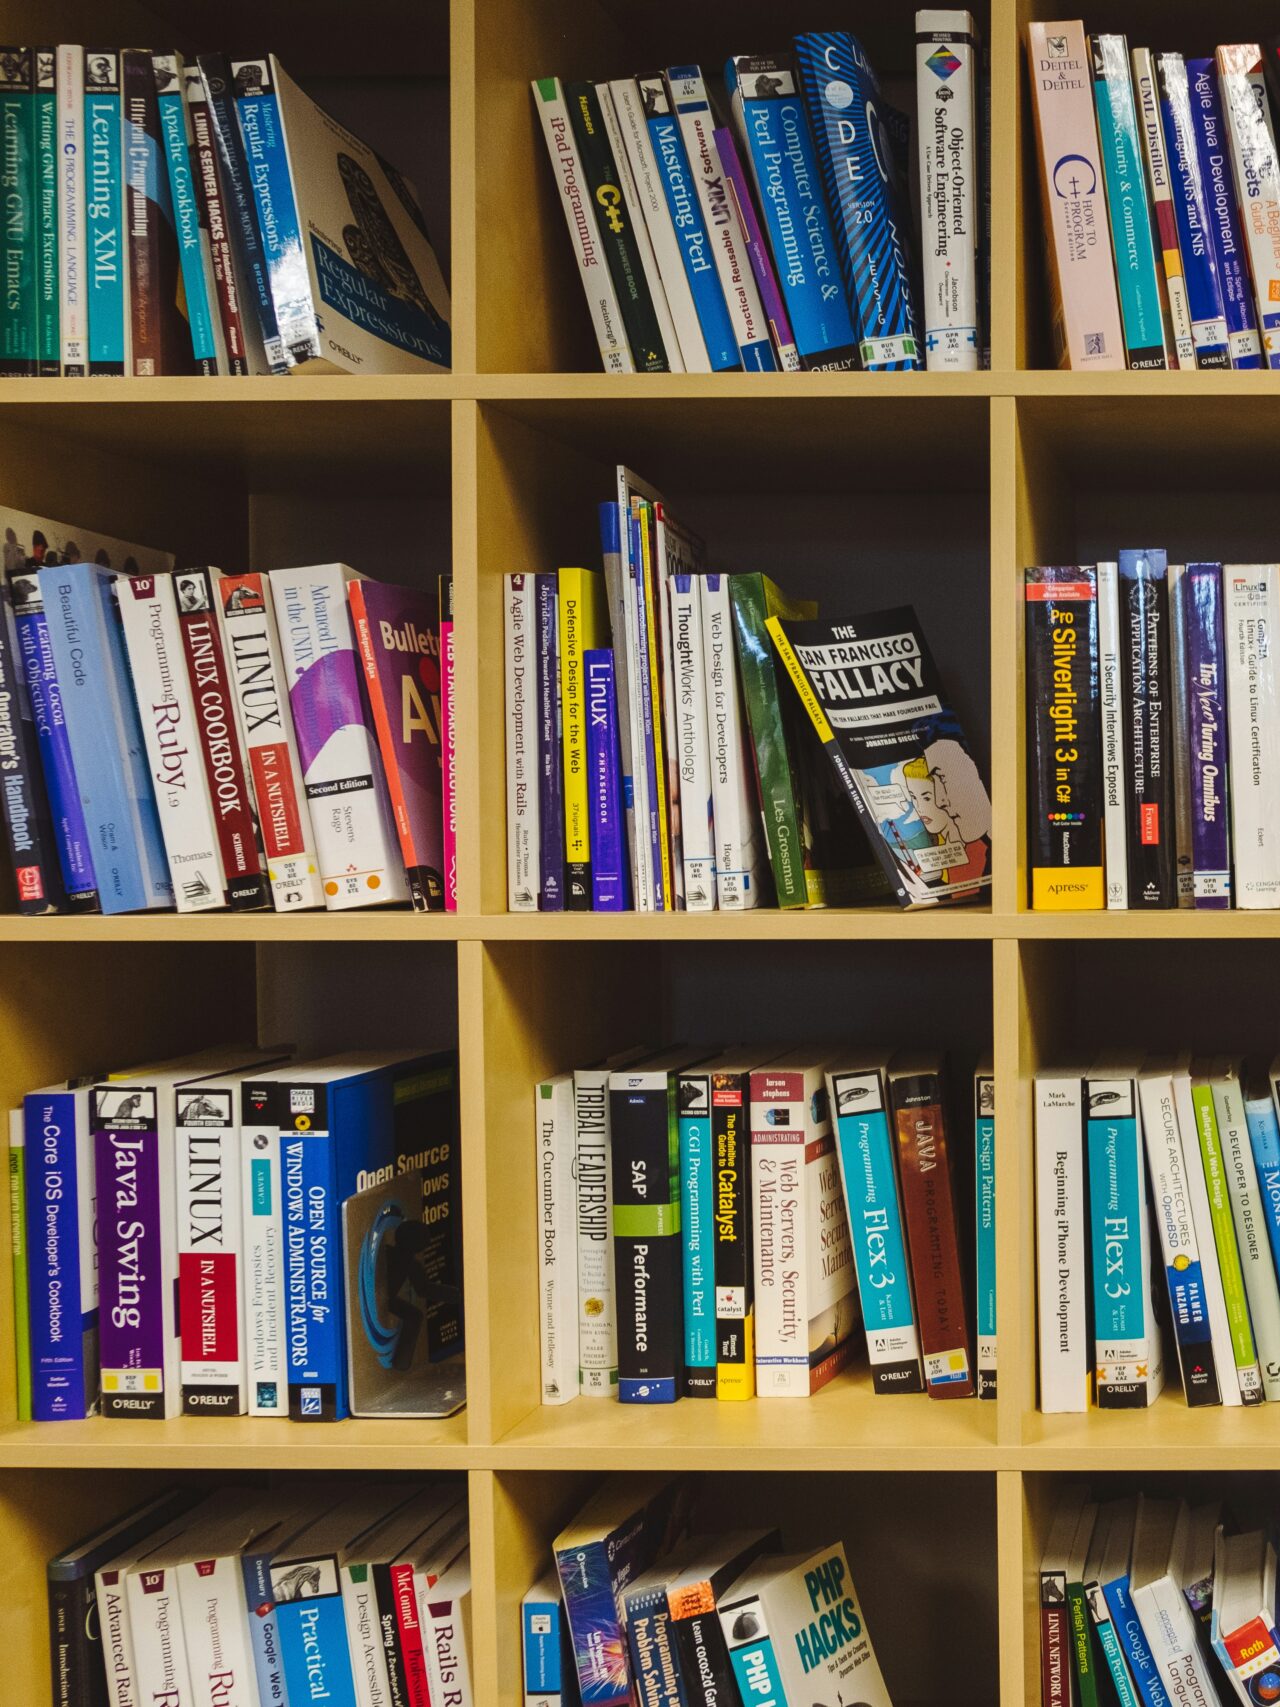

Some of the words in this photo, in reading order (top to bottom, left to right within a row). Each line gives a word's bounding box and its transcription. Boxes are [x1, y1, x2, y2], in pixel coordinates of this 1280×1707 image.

[1196, 73, 1213, 109] Agile
[193, 112, 210, 147] LINUX
[934, 107, 948, 169] Software
[1140, 77, 1154, 119] UML
[1149, 122, 1165, 186] Distilled
[1204, 114, 1217, 148] Java
[89, 103, 114, 219] Learning
[163, 103, 183, 162] Apache
[175, 166, 196, 249] Cookbook
[201, 150, 217, 196] SERVER
[242, 104, 263, 161] Regular
[253, 164, 280, 252] Expressions
[950, 127, 965, 235] Object-Oriented
[206, 199, 224, 240] HACKS
[550, 117, 570, 153] iPad
[562, 156, 598, 268] Programming
[655, 125, 694, 228] Mastering
[684, 231, 711, 272] Perl
[935, 172, 951, 257] Engineering
[1210, 155, 1236, 255] Development
[94, 227, 116, 288] XML
[951, 276, 959, 312] Jacobson
[58, 584, 79, 644] Beautiful
[70, 649, 87, 686] Code
[359, 619, 372, 661] Bulletproof
[367, 662, 377, 679] Ajax
[566, 600, 578, 657] Defensive
[832, 637, 915, 665] FRANCISCO
[567, 660, 578, 699] Design
[589, 664, 610, 725] Linux
[810, 658, 924, 700] FALLACY
[1050, 628, 1078, 742] Silverlight
[568, 703, 580, 720] for
[569, 724, 580, 744] the
[152, 701, 189, 789] Ruby
[187, 621, 208, 683] LINUX
[202, 692, 240, 815] COOKBOOK
[232, 833, 246, 871] SCHRODER
[570, 748, 581, 773] Web
[679, 713, 697, 783] Anthology
[1055, 748, 1077, 762] 3
[598, 752, 608, 824] PHRASEBOOK
[572, 803, 580, 837] 37signals
[1145, 807, 1154, 841] FOWLER
[43, 1106, 53, 1122] The
[542, 1120, 554, 1146] The
[578, 1085, 605, 1137] TRIBAL
[43, 1125, 59, 1163] Core
[109, 1135, 144, 1207] Java
[46, 1171, 62, 1199] iOS
[188, 1136, 222, 1245] LINUX
[286, 1142, 304, 1220] WINDOWS
[543, 1151, 555, 1225] Cucumber
[578, 1145, 607, 1241] LEADERSHIP
[715, 1170, 736, 1242] Catalyst
[1054, 1151, 1069, 1216] Beginning
[43, 1205, 61, 1276] Developer's
[544, 1230, 556, 1266] Book
[863, 1208, 889, 1266] Flex
[1057, 1220, 1068, 1265] iPhone
[112, 1221, 145, 1328] Swing
[289, 1225, 307, 1366] ADMINISTRATORS
[633, 1244, 649, 1351] Performance
[869, 1272, 895, 1288] 3
[1176, 1285, 1189, 1324] NAZARIO
[1190, 1283, 1202, 1322] PALMER
[49, 1281, 62, 1342] Cookbook
[1056, 1269, 1070, 1353] Development
[397, 1572, 417, 1629] McConnell
[804, 1555, 845, 1613] PHP
[106, 1593, 128, 1672] Advanced
[381, 1614, 395, 1646] Spring
[795, 1598, 860, 1674] HACKS
[1072, 1598, 1083, 1632] Perlish
[300, 1607, 330, 1699] Practical
[742, 1650, 772, 1700] PHP
[1076, 1633, 1089, 1673] Patterns
